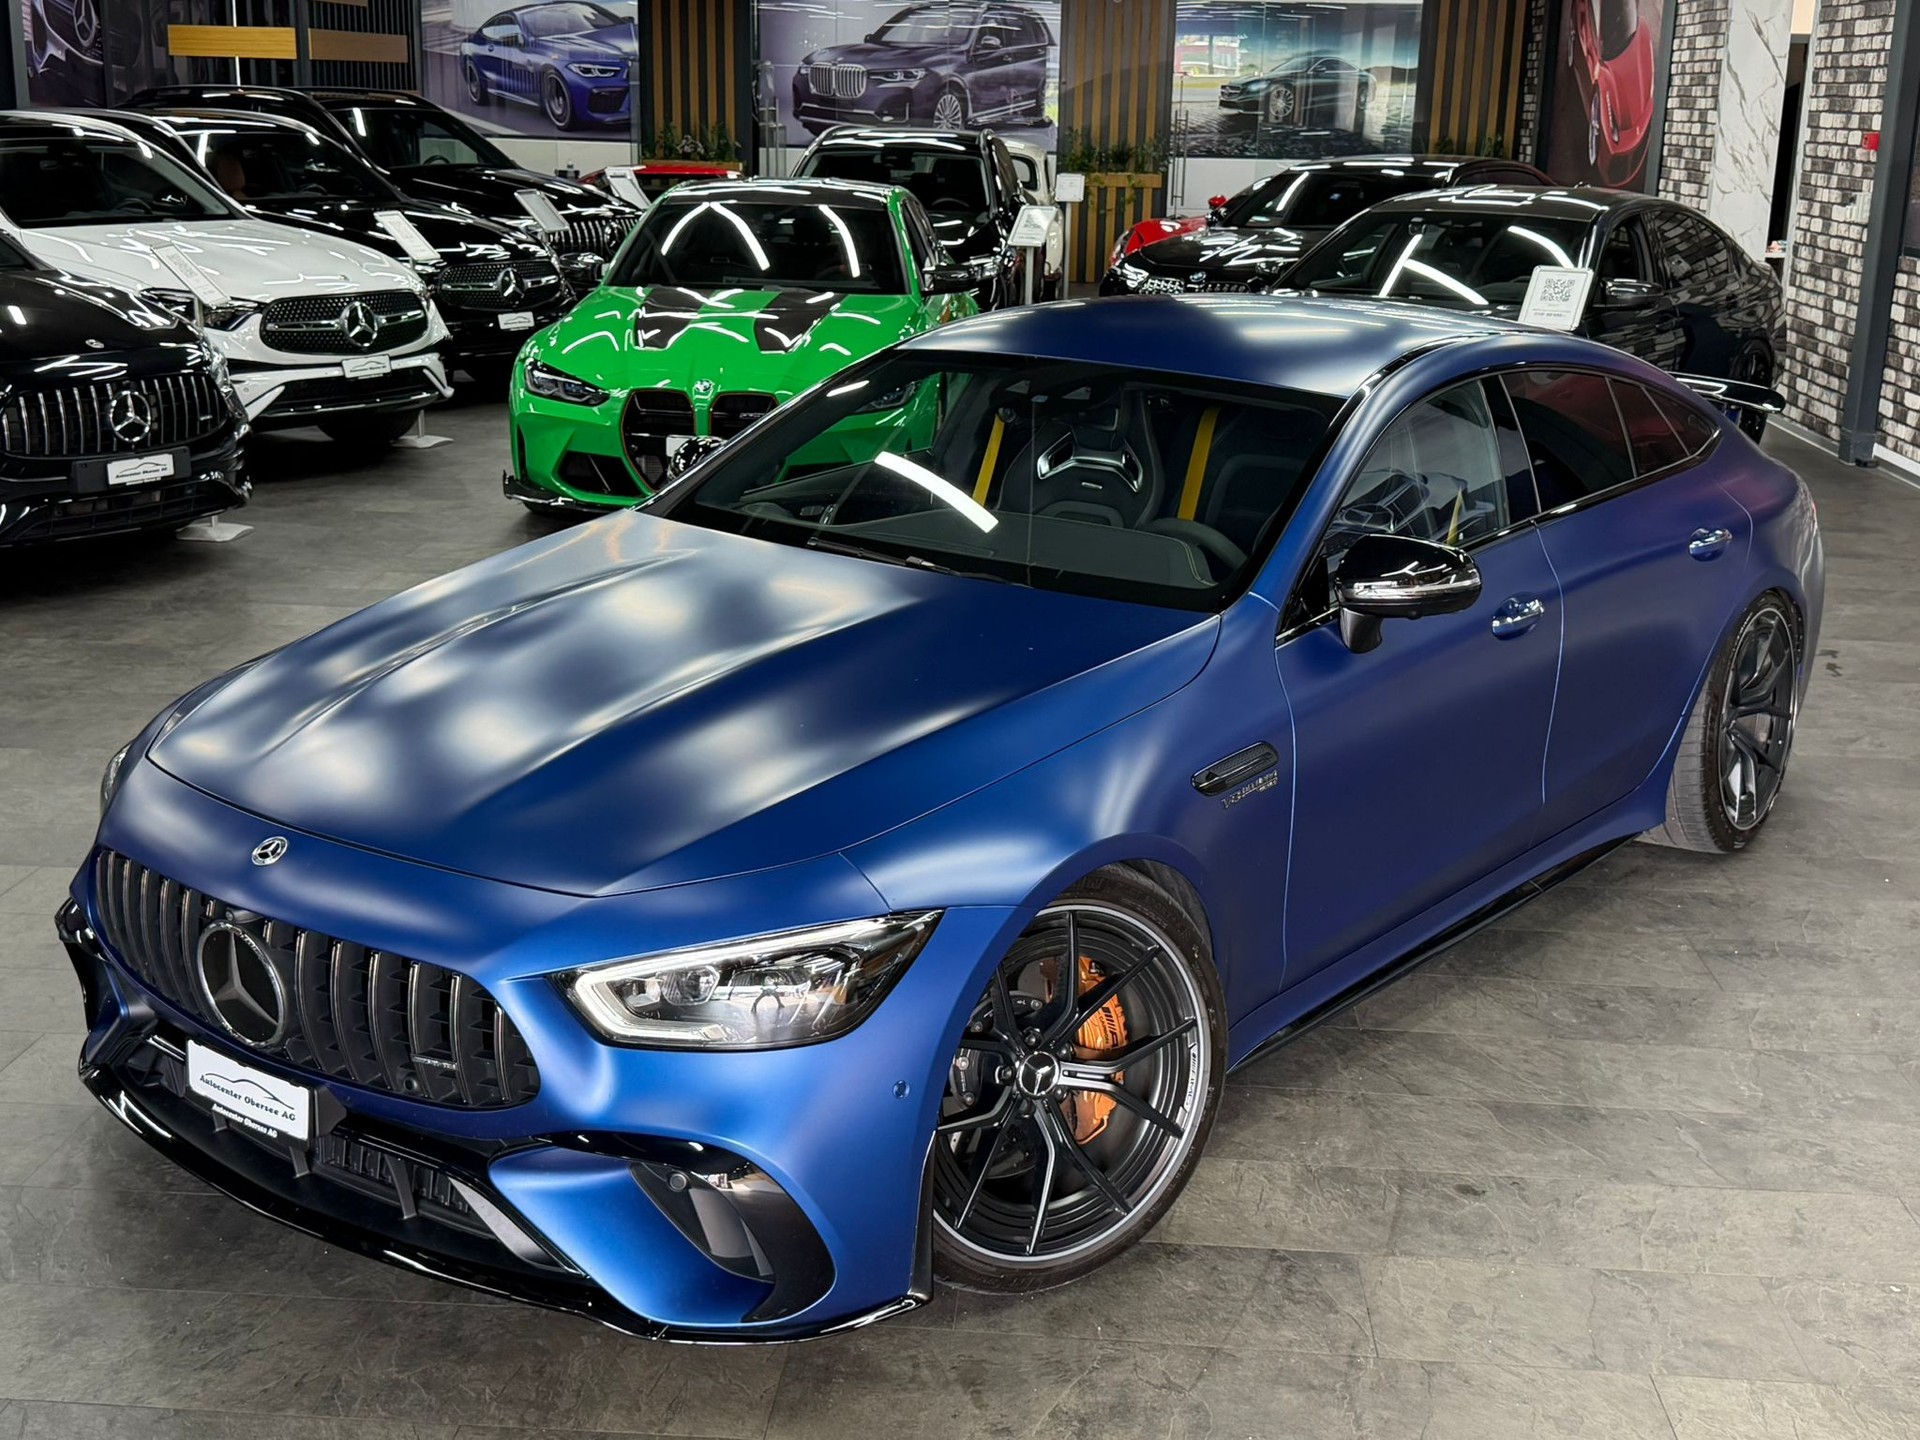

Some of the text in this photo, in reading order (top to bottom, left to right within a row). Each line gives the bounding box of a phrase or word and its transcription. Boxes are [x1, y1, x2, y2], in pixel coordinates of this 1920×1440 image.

[199, 1074, 296, 1122] Autocenter Obersee AG
[212, 1103, 278, 1138] Autocenter Obersee AG
